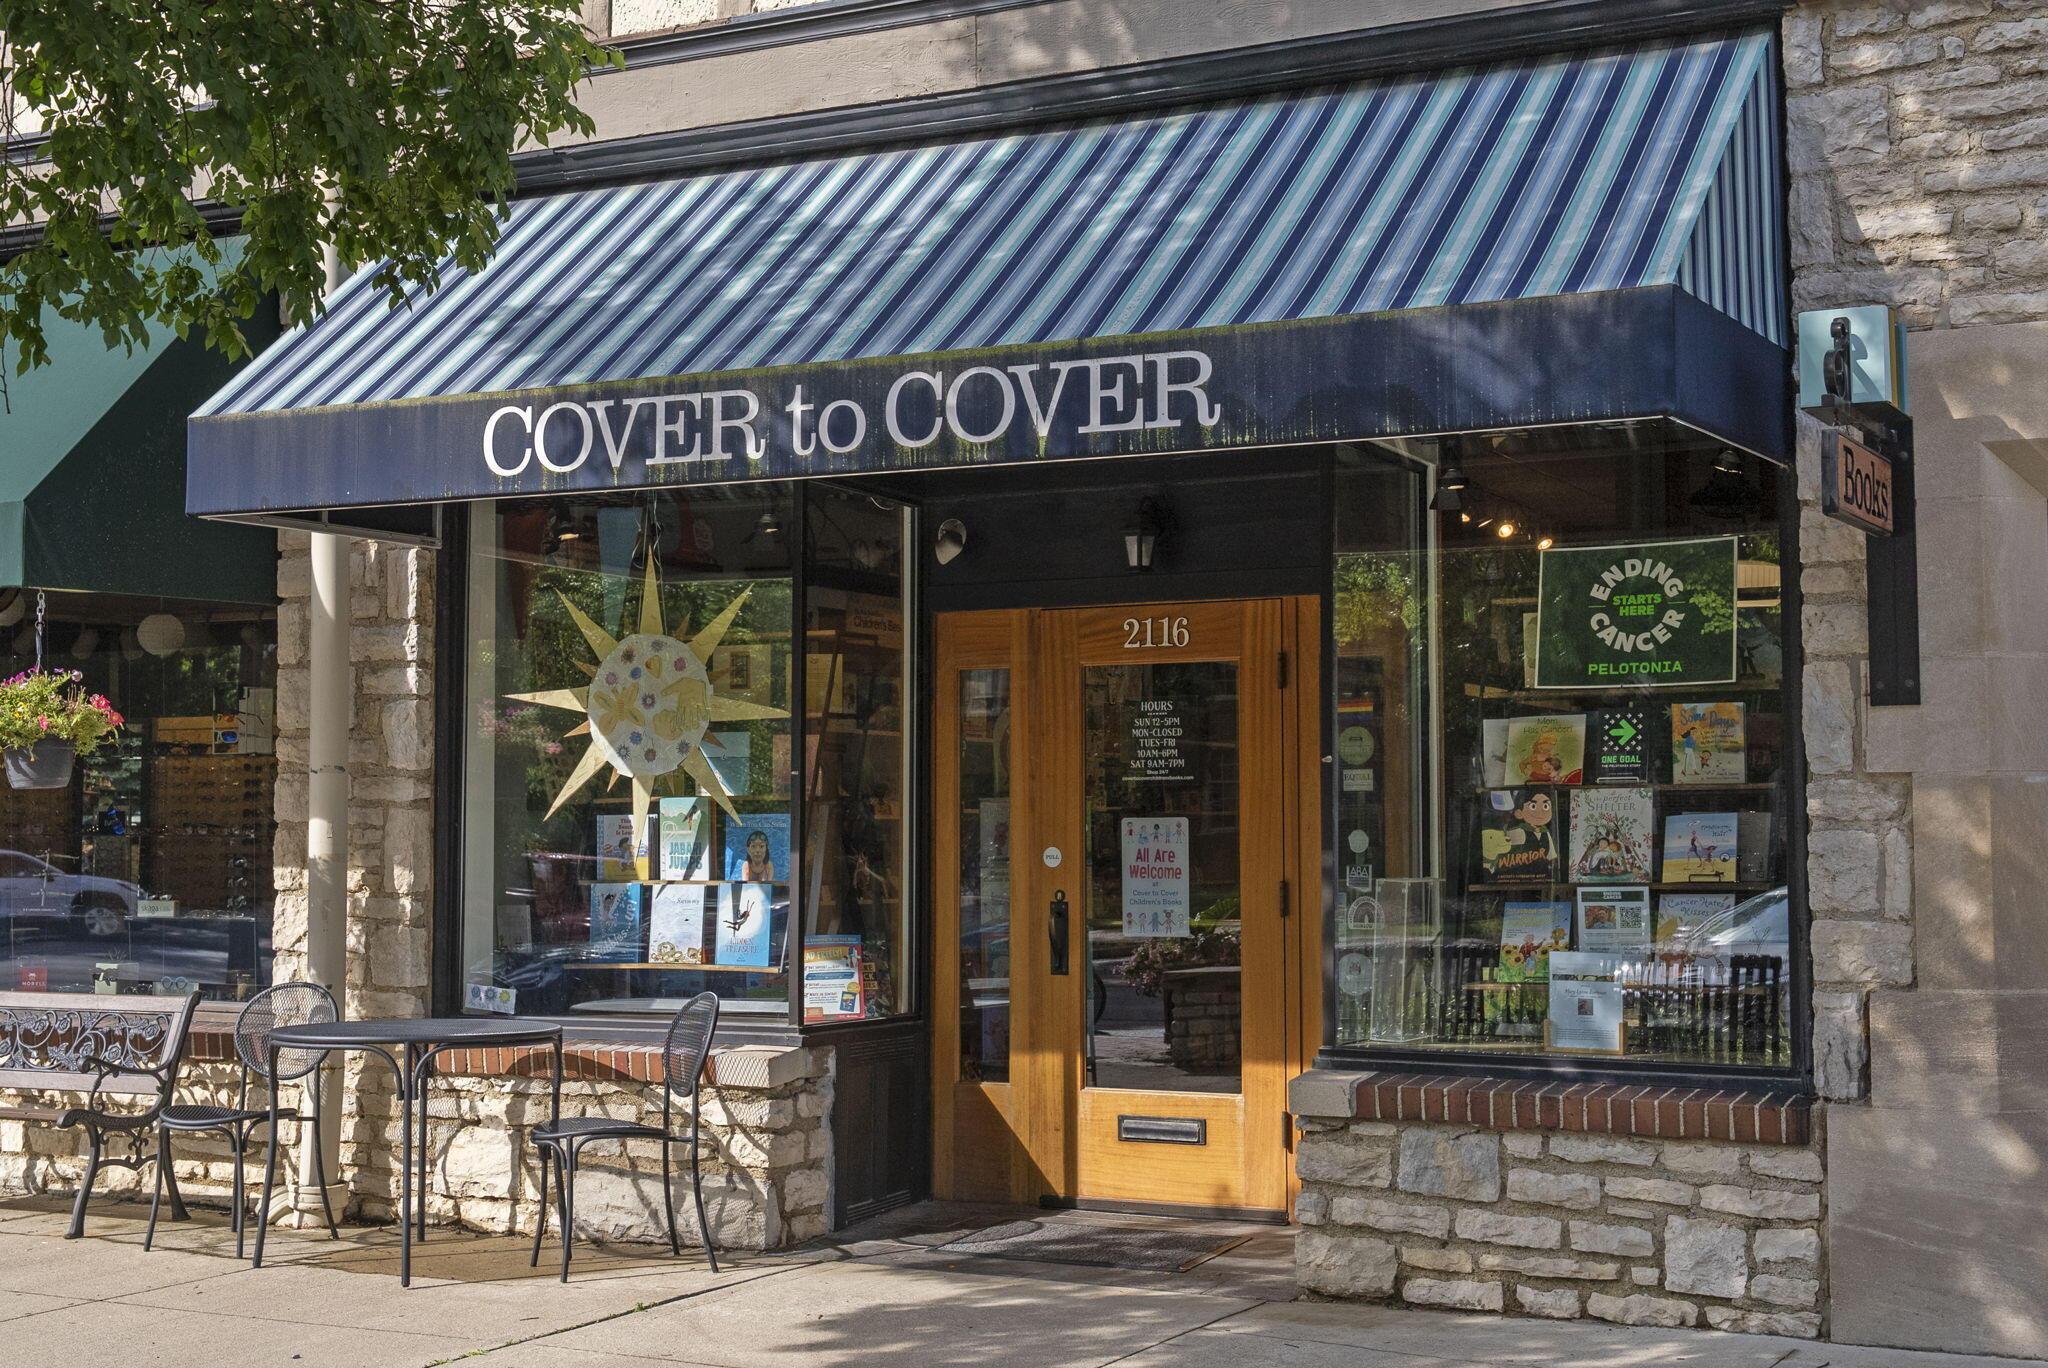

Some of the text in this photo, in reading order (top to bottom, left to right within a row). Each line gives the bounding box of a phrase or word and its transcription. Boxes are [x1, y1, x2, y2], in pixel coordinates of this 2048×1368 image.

[483, 350, 1221, 477] COVER to COVER
[1843, 445, 1889, 522] Books
[1590, 558, 1684, 601] ENDING
[1612, 593, 1662, 606] STARTS
[1619, 605, 1655, 616] HERE
[1123, 617, 1190, 648] 2116
[1590, 609, 1686, 653] CANCER
[1588, 660, 1683, 675] PELOTONIA
[1140, 701, 1173, 711] HOURS
[1134, 717, 1180, 727] SUN 12-5PM
[1132, 728, 1183, 737] MON-CLOSED
[1139, 738, 1176, 747] TUES-FRI
[1137, 749, 1178, 758] 10AM-6PM
[1601, 755, 1641, 764] ONE GOAL
[1130, 759, 1185, 768] SAT 9AM-7PM
[1587, 801, 1636, 811] SHELTER
[1135, 848, 1175, 862] All Are
[1498, 847, 1547, 868] WARRIOR
[669, 855, 703, 871] JUMPS
[1129, 864, 1182, 879] Welcome
[1667, 897, 1725, 908] Cancer Hates
